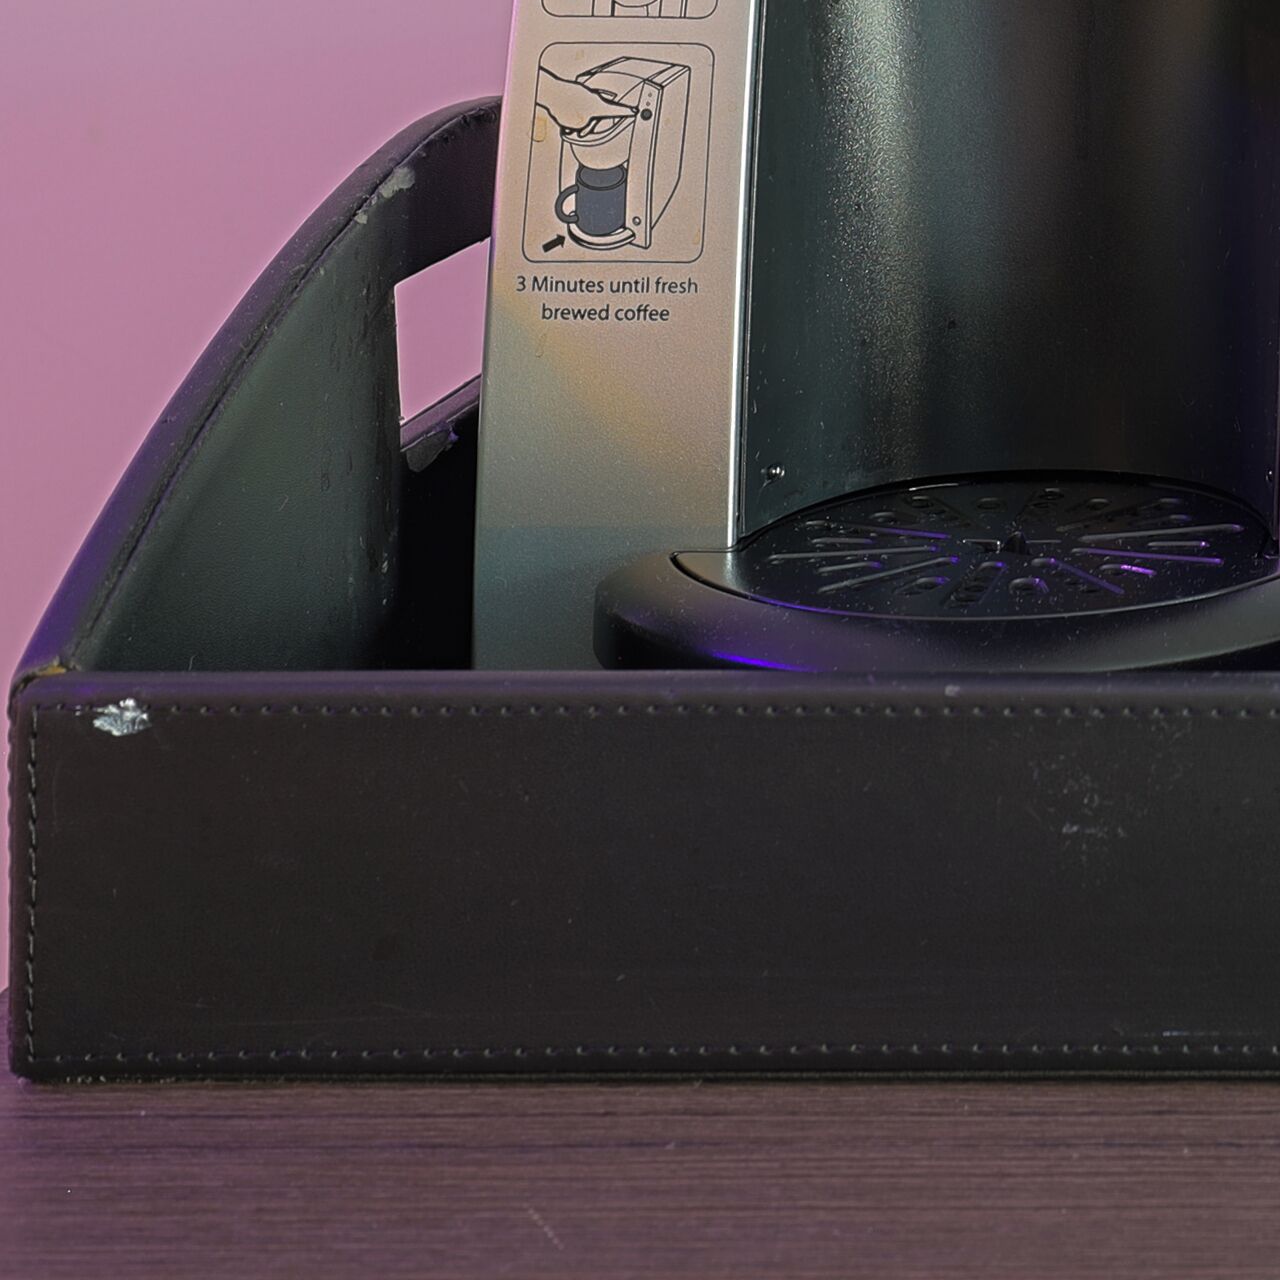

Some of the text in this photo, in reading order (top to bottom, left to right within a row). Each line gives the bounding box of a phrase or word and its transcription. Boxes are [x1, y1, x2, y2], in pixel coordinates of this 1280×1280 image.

[516, 276, 698, 294] 3 Minutes until fresh
[541, 303, 670, 321] brewed coffee
